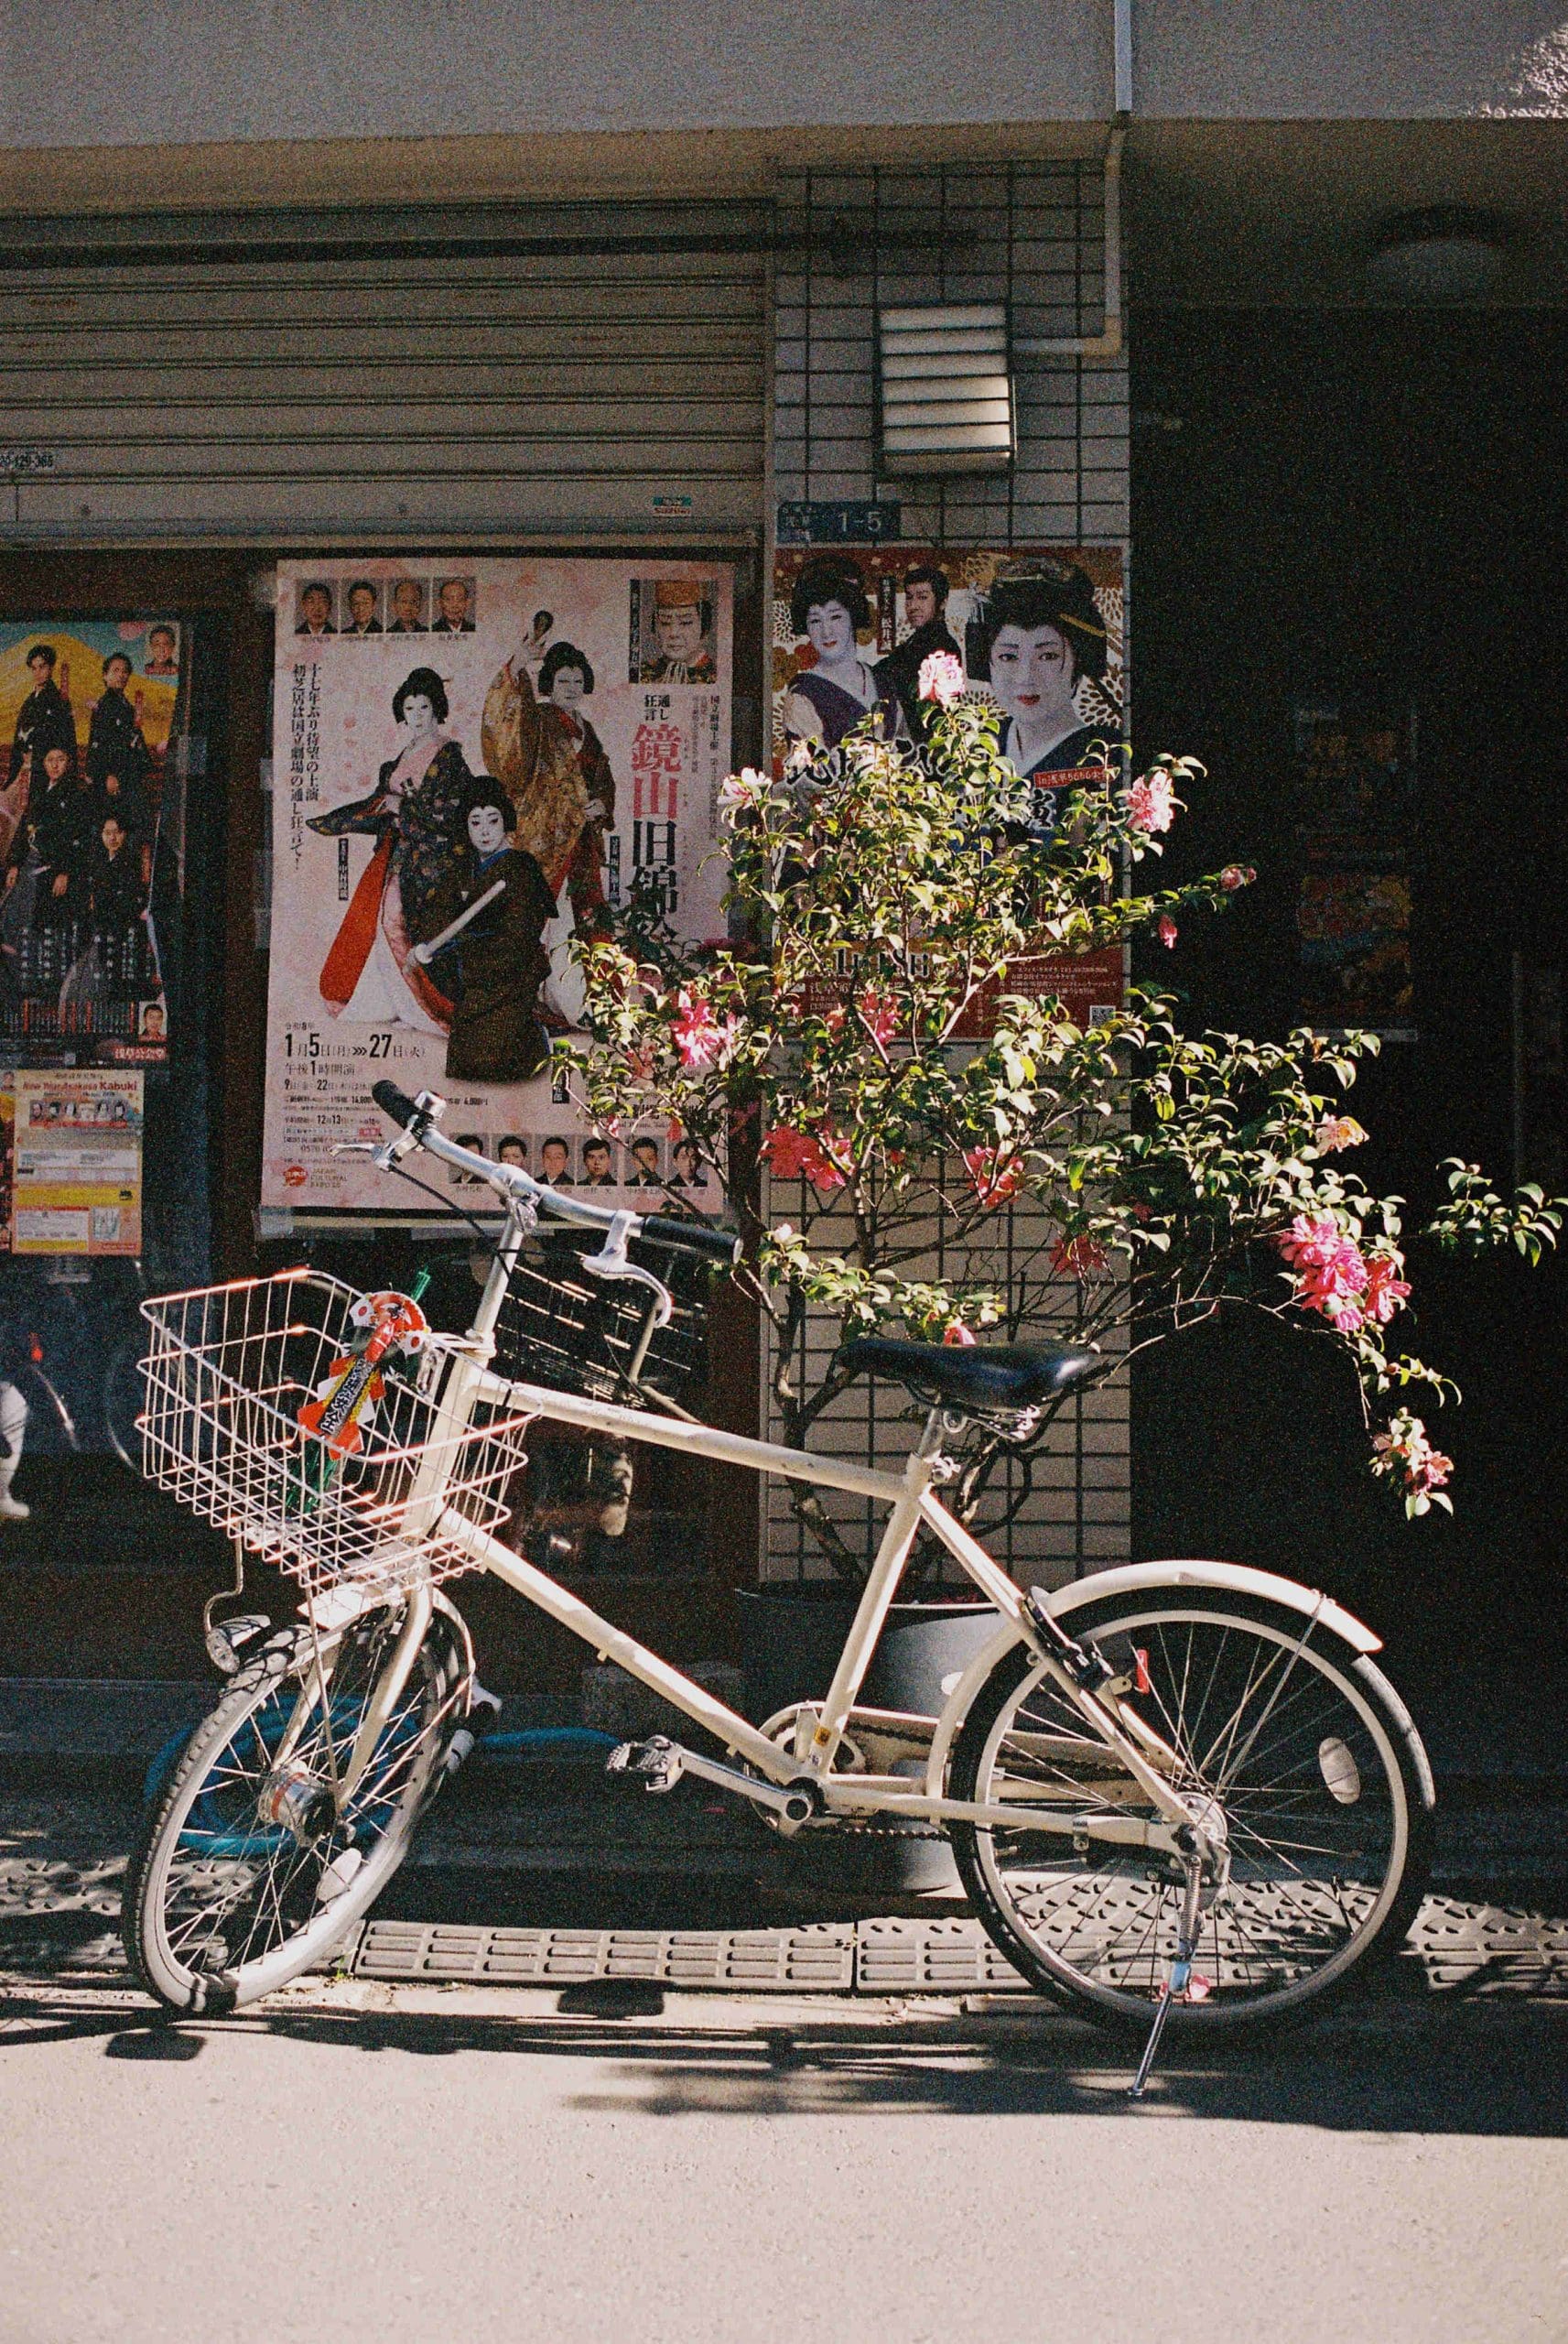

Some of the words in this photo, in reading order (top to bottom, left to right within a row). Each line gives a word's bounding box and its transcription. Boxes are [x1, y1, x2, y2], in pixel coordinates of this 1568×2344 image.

[838, 511, 881, 533] 1-5
[306, 663, 321, 802] 十七年ぶり待望の上演
[285, 1060, 355, 1076] 午後1時開演
